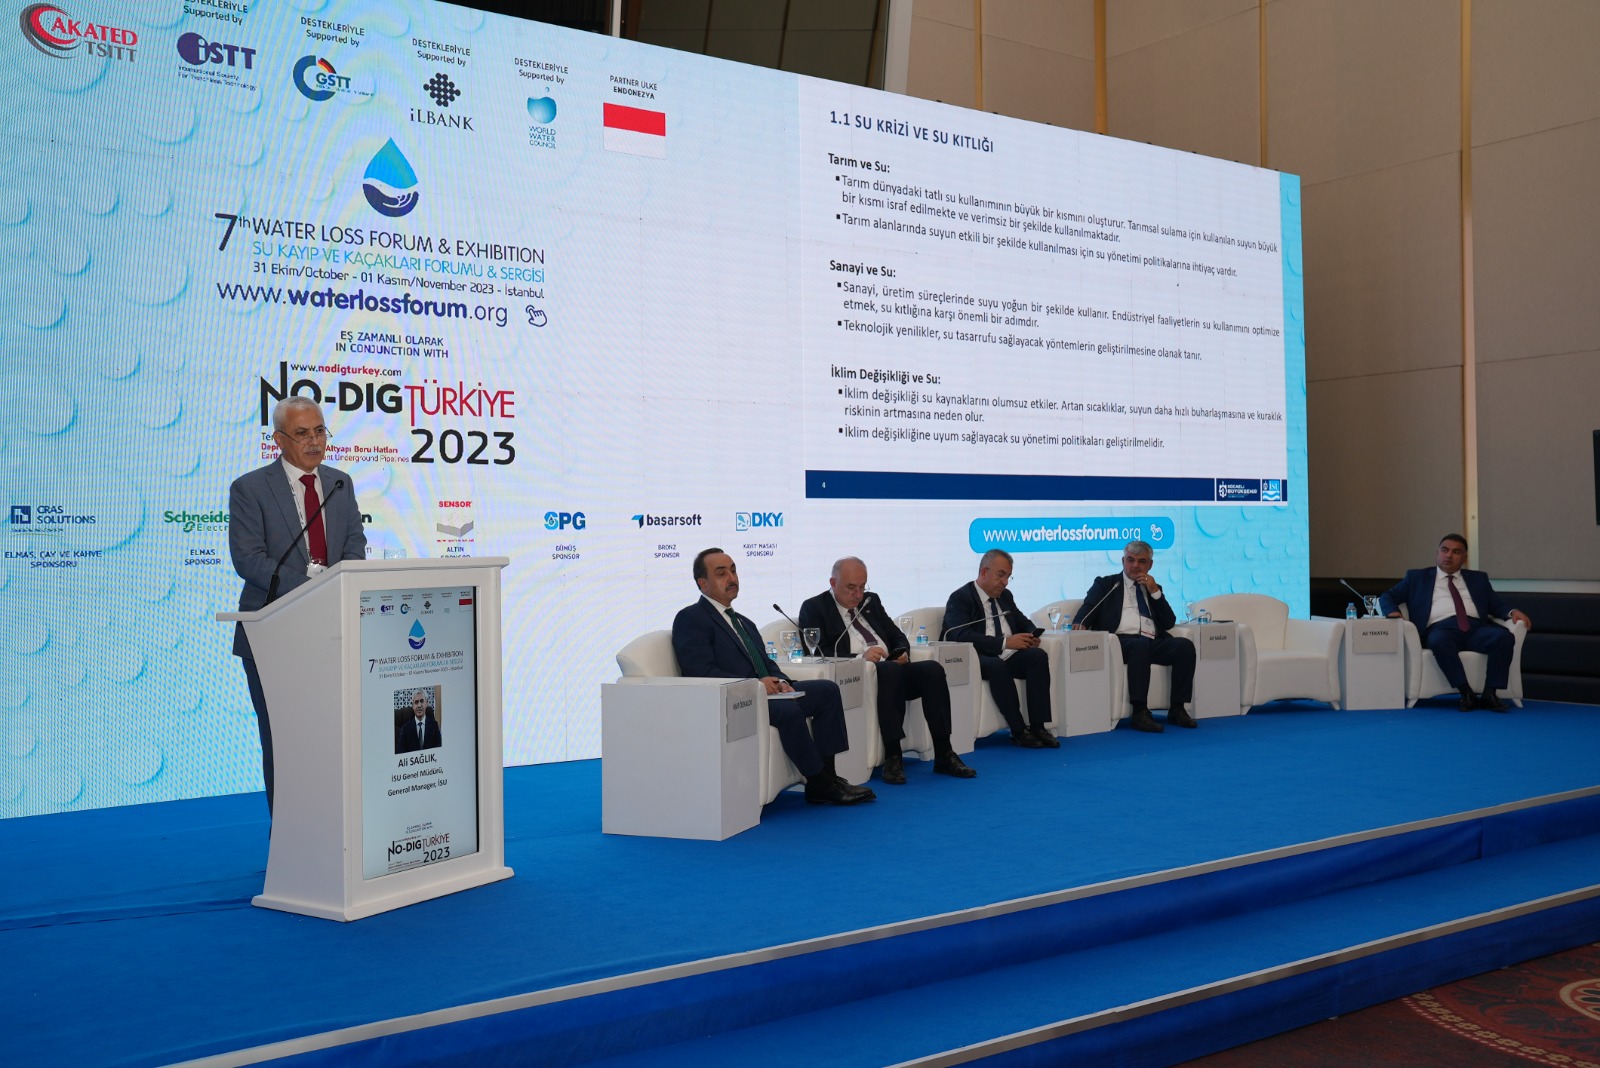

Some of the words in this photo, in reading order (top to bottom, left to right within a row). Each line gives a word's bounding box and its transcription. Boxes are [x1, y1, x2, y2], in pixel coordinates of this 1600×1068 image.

[183, 5, 230, 22] Supported
[232, 13, 242, 26] by
[51, 16, 138, 46] AKATED
[301, 16, 364, 36] DESTEKLERİYLE
[306, 29, 348, 44] Supported
[350, 38, 360, 48] by
[412, 38, 470, 56] DESTEKLERİYLE
[85, 42, 138, 62] TSITT
[417, 50, 455, 64] Supported
[458, 58, 467, 68] by
[514, 58, 568, 74] DESTEKLERİYLE
[316, 72, 351, 89] GSTT
[519, 69, 554, 83] Supported
[556, 76, 565, 86] by
[610, 75, 639, 88] PARTNER
[614, 86, 655, 100] ENDONEZYA
[529, 125, 556, 136] WORLD
[529, 132, 556, 143] WATER
[830, 110, 850, 126] 1.1
[855, 115, 872, 130] SU
[877, 119, 909, 136] KRİZİ
[913, 126, 928, 140] VE
[933, 130, 948, 144] SU
[953, 134, 994, 153] KITLIĞI
[828, 153, 857, 168] Tarım
[860, 160, 872, 170] ve
[875, 161, 890, 173] Su:
[842, 175, 870, 190] Tarım
[873, 180, 922, 198] dünyadaki
[924, 189, 943, 202] tatlı
[946, 194, 956, 204] su
[959, 193, 1012, 212] kullanımının
[1014, 200, 1040, 217] büyük
[1042, 207, 1054, 219] bir
[1056, 209, 1085, 223] kısmını
[1088, 213, 1125, 229] oluşturur.
[1128, 220, 1159, 234] Tarımsal
[1161, 226, 1187, 238] sulama
[1189, 229, 1201, 242] için
[1237, 238, 1256, 250] suyun
[1258, 241, 1278, 254] büyük
[253, 217, 316, 240] WATER
[322, 225, 364, 246] LOSS
[370, 230, 432, 253] FORUM
[438, 238, 451, 254] &
[456, 240, 545, 264] EXHIBITION
[253, 241, 273, 256] SU
[278, 244, 319, 261] KAYIP
[322, 248, 339, 263] VE
[344, 251, 421, 270] KAÇAKLARI
[425, 258, 483, 277] FORUMU
[487, 266, 497, 279] &
[500, 266, 545, 283] SERGİSİ
[830, 260, 864, 275] Sanayi
[866, 266, 878, 276] ve
[881, 266, 896, 278] Su:
[253, 262, 266, 273] 31
[272, 264, 349, 281] Ekim/October
[361, 272, 373, 283] 01
[378, 274, 467, 292] Kasım/November
[470, 282, 494, 294] 2023
[505, 284, 545, 299] İstanbul
[216, 282, 508, 327] www.waterlossforum.org
[340, 330, 353, 343] EŞ
[358, 332, 402, 344] ZAMANLI
[406, 335, 444, 346] OLARAK
[844, 320, 894, 336] Teknolojik
[896, 324, 940, 340] yenilikler,
[943, 330, 954, 340] su
[956, 329, 996, 344] tasarrufu
[999, 333, 1044, 348] sağlayacak
[1046, 337, 1095, 352] yöntemlerin
[1158, 347, 1182, 359] olanak
[1184, 349, 1202, 361] tanır.
[335, 343, 346, 352] IN
[350, 343, 420, 356] CONJUNCTION
[423, 349, 449, 358] WITH
[291, 363, 402, 377] www.nodigturkey.com
[831, 364, 857, 380] İklim
[860, 368, 910, 384] Değişikliği
[912, 374, 923, 384] ve
[926, 374, 941, 385] Su:
[404, 379, 514, 426] TÜRKİYE
[844, 426, 869, 439] İklim
[872, 428, 930, 443] değişikliğine
[933, 432, 959, 443] uyum
[961, 430, 1008, 445] sağlayacak
[1010, 434, 1020, 444] su
[1022, 433, 1059, 446] yönetimi
[1061, 435, 1104, 447] politikaları
[411, 428, 516, 465] 2023
[37, 506, 63, 514] CRAS
[164, 511, 230, 523] Schneide
[37, 516, 96, 524] SOLUTIONS
[752, 512, 783, 527] DKY
[983, 524, 1140, 541] www.waterlossforum.org
[398, 758, 408, 768] Ali
[402, 771, 418, 780] Genel
[388, 786, 410, 796] General
[388, 840, 422, 862] NO-DIG
[424, 846, 450, 863] 2023
